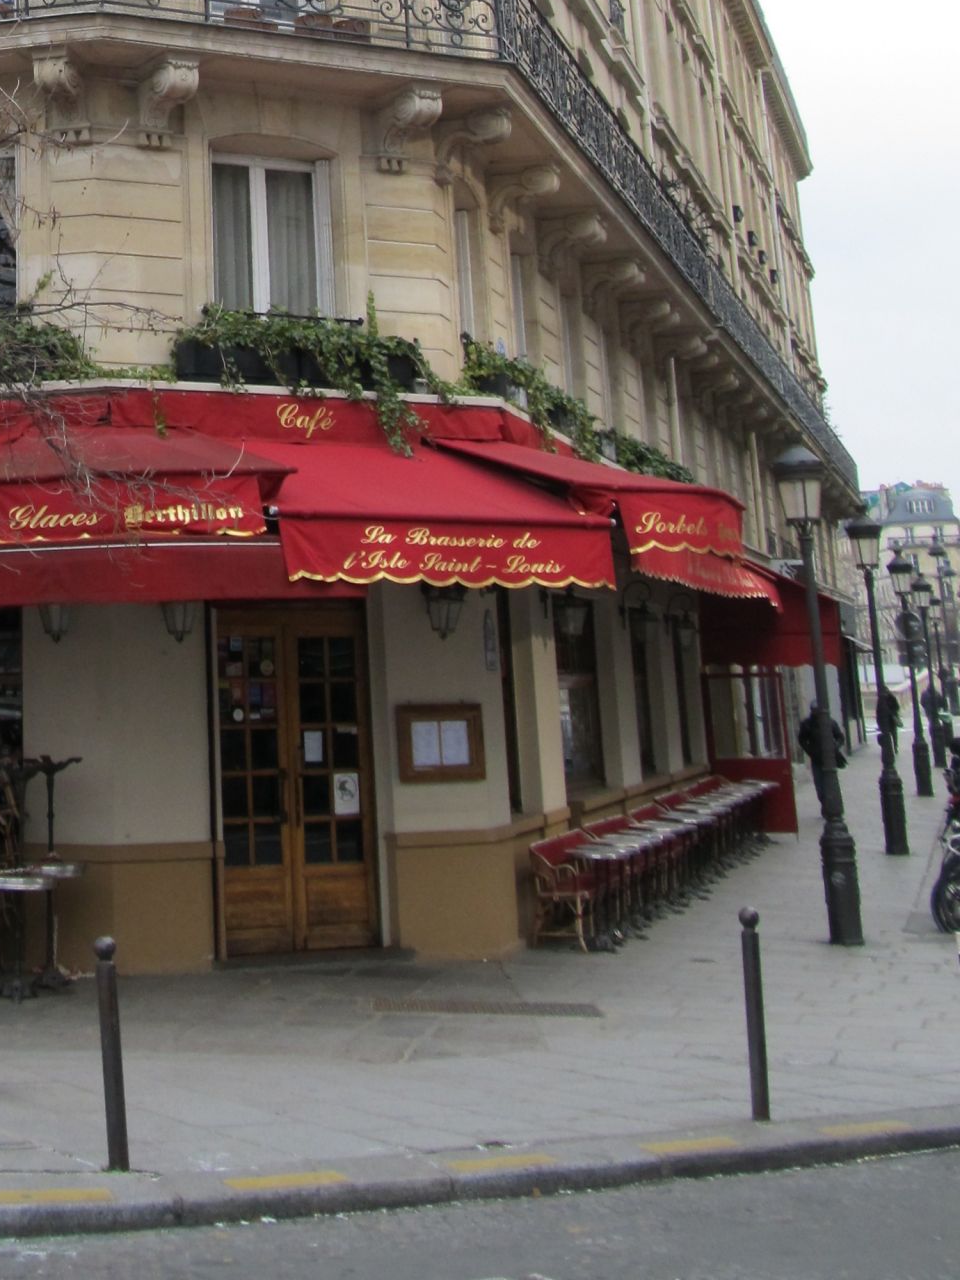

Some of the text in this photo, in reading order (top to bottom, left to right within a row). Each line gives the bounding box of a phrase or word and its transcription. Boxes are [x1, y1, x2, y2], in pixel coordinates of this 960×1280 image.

[277, 403, 337, 438] Café
[9, 503, 245, 530] Glaces Berthillon
[635, 511, 709, 537] Sorbets
[361, 525, 542, 549] La Brasserie de
[343, 549, 411, 570] l'Isle
[419, 552, 482, 573] Saint
[502, 554, 565, 574] Louis
